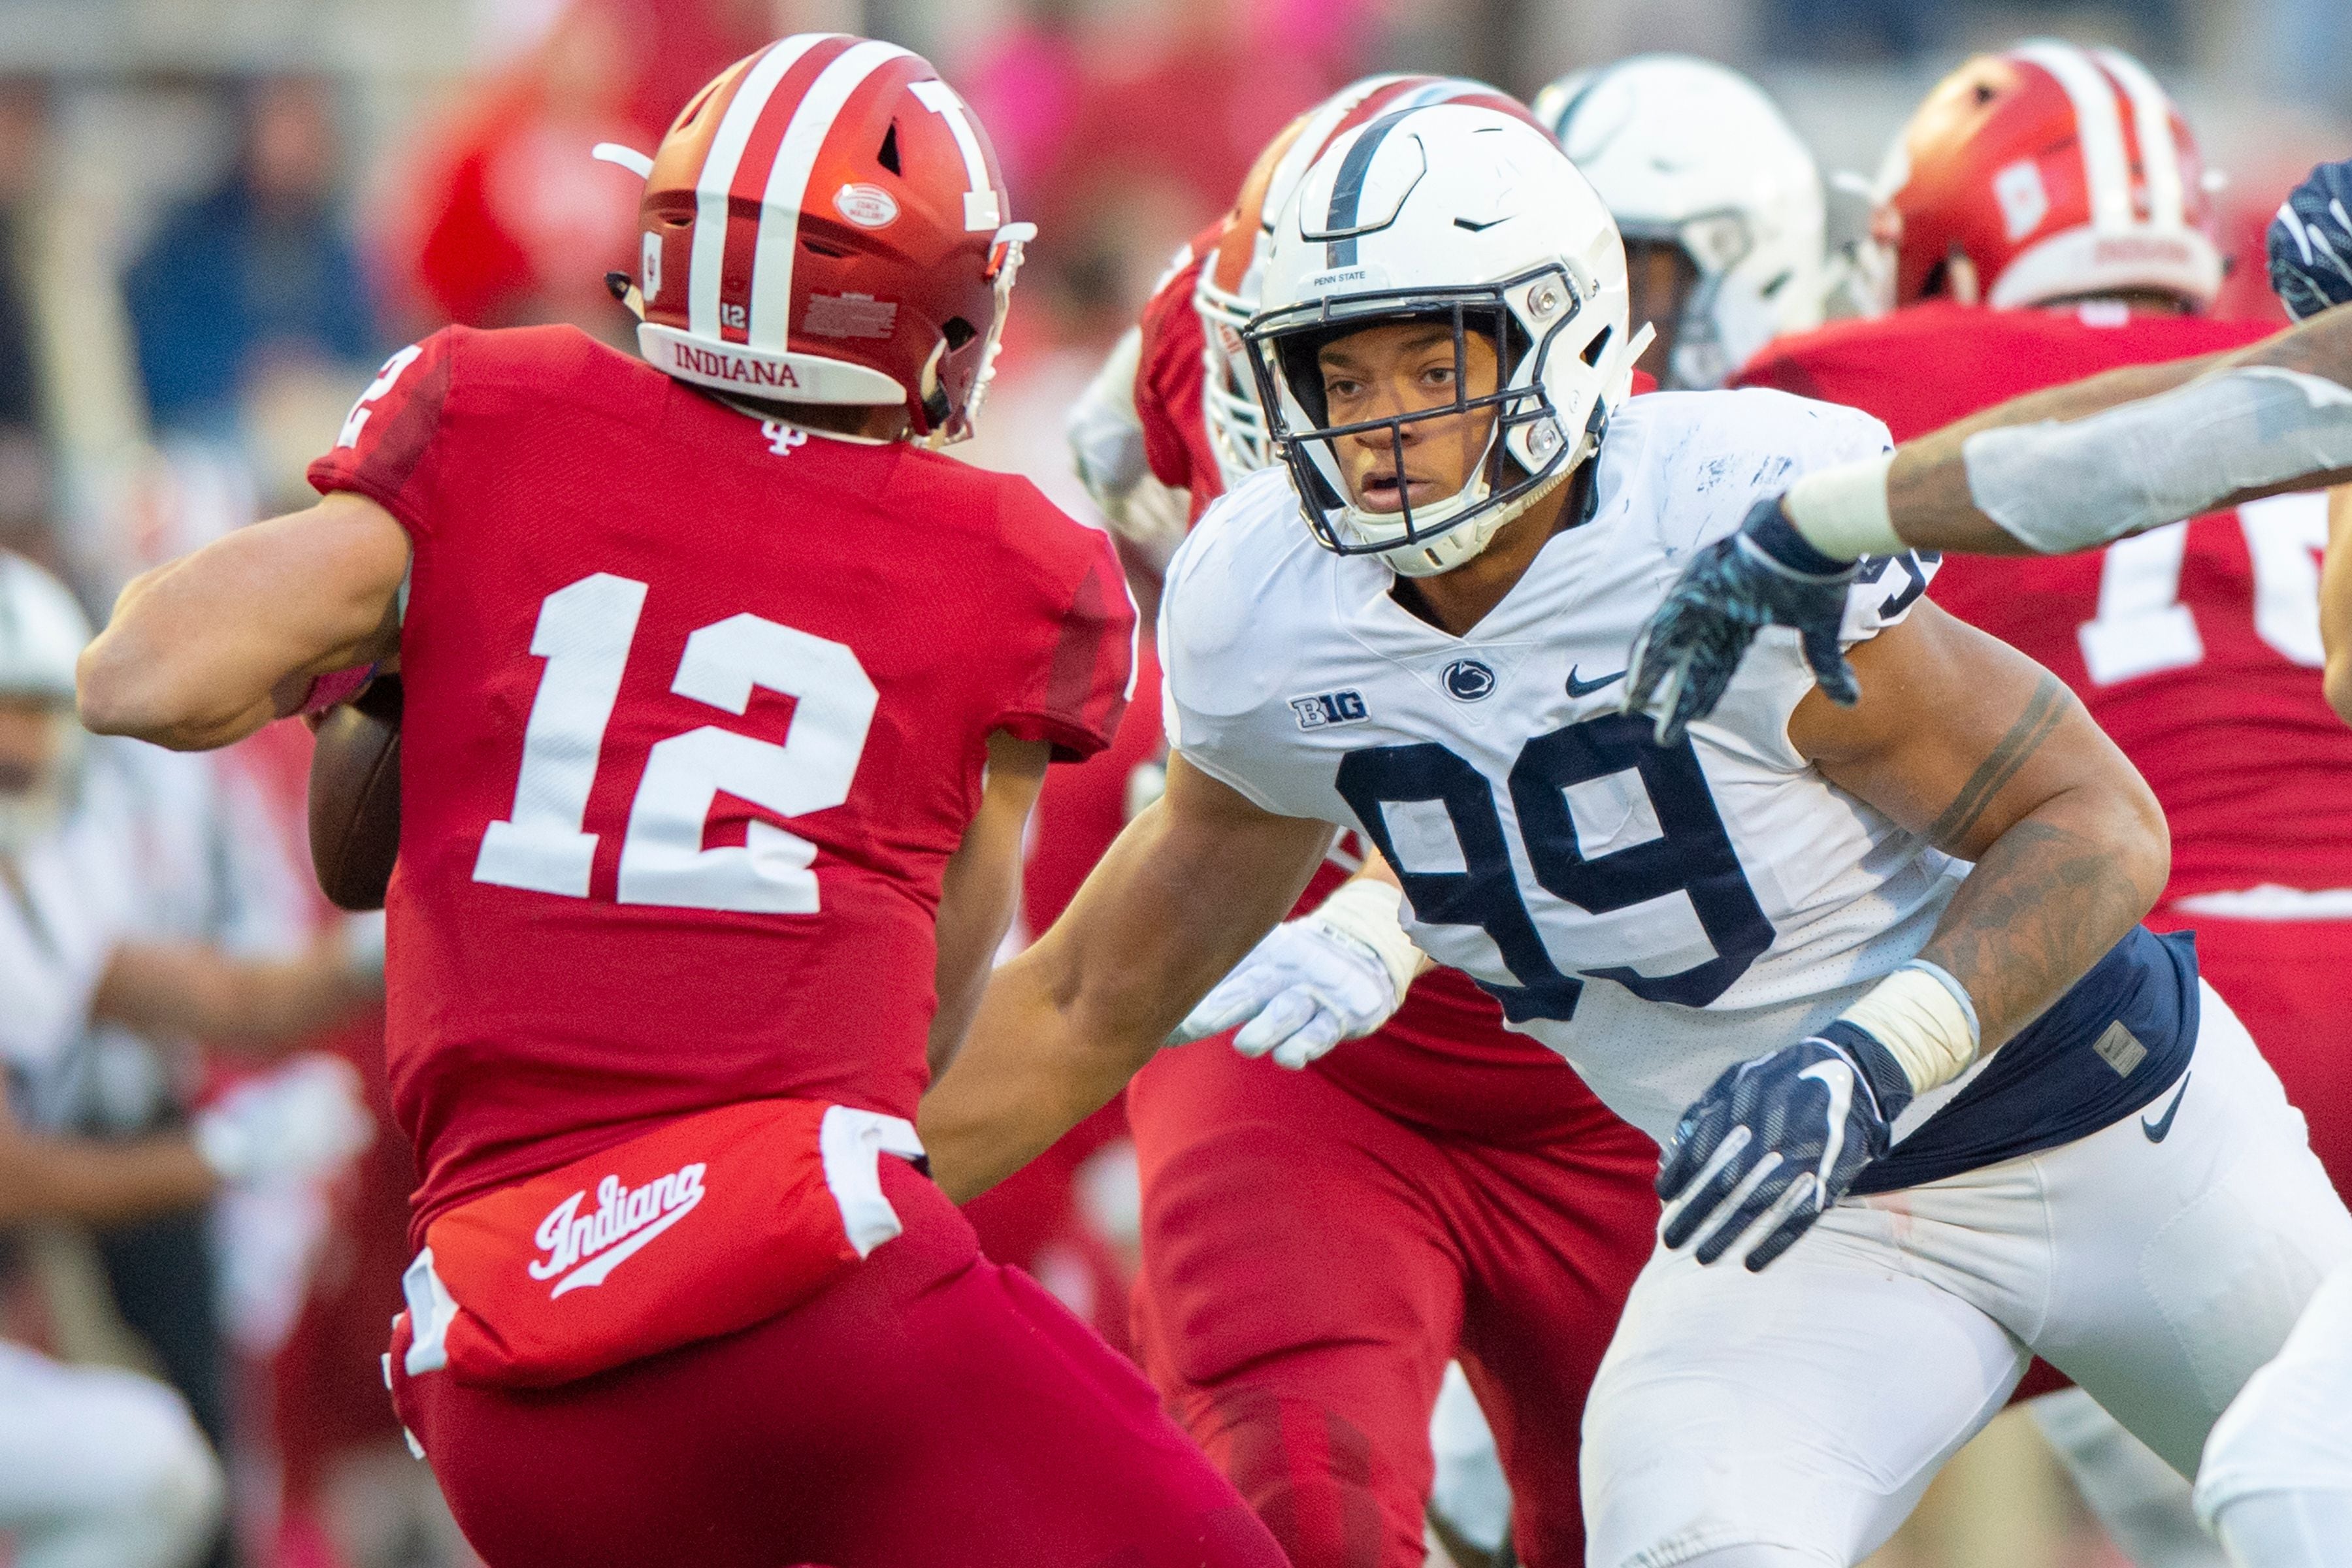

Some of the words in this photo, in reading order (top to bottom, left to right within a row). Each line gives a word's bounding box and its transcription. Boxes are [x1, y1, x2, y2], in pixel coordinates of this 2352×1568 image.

[721, 302, 746, 329] 12
[1313, 275, 1337, 287] PENN
[1338, 270, 1366, 282] STATE
[674, 341, 800, 388] INDIANA
[472, 571, 881, 915] 12
[1335, 710, 1778, 1024] 99
[527, 1162, 707, 1282] Indiana
